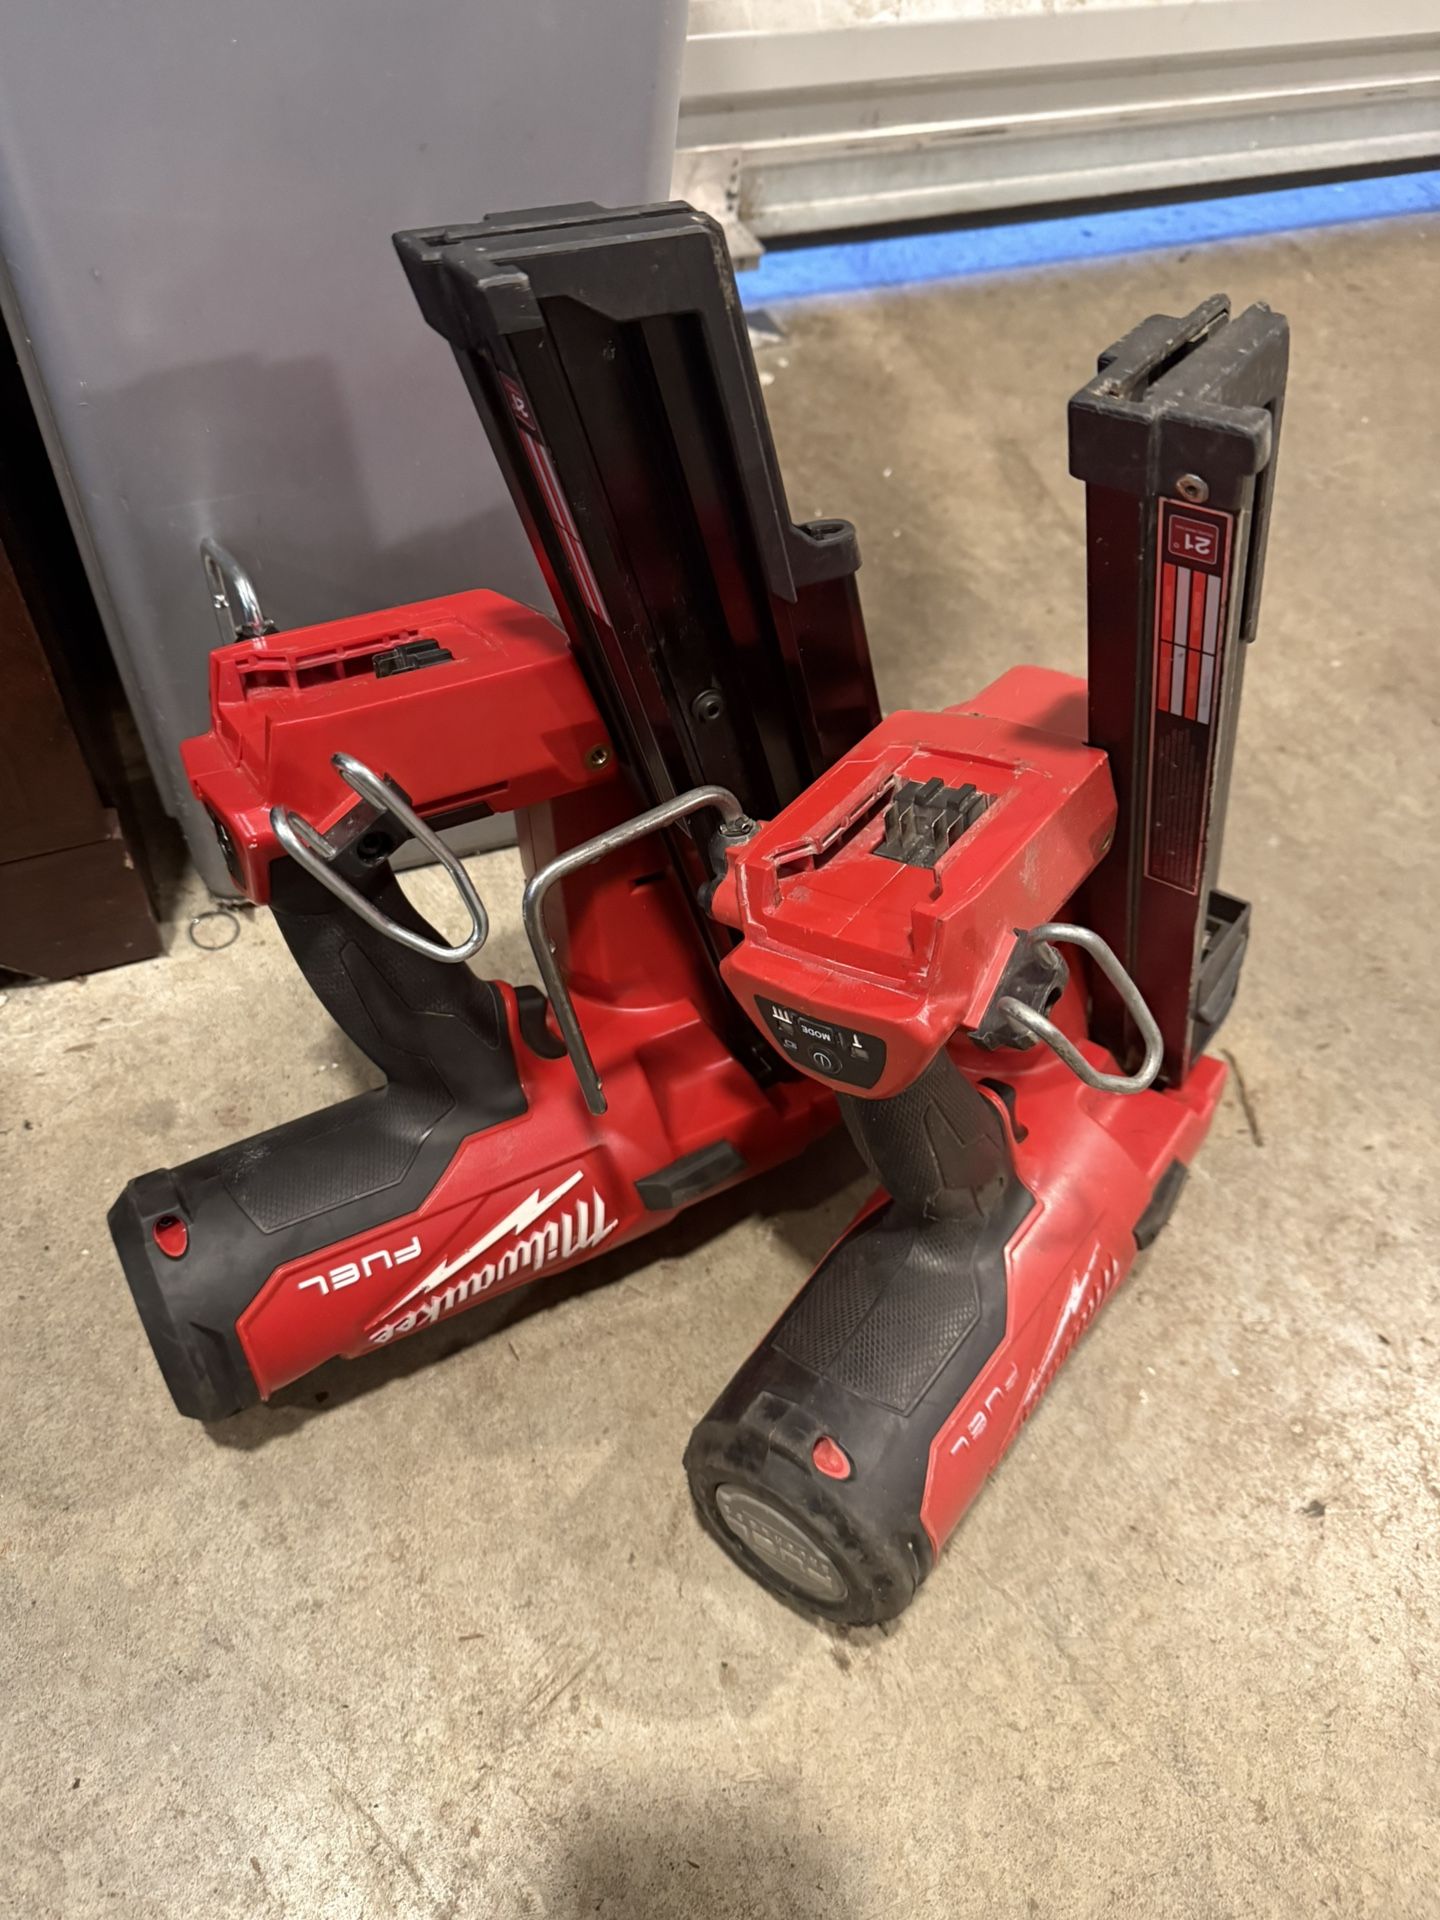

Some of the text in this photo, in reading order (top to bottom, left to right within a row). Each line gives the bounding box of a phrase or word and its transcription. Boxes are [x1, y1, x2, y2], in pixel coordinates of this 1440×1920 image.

[801, 1025, 831, 1042] MODE
[298, 1236, 422, 1295] FUEL
[368, 1186, 619, 1344] Milwaukee
[950, 1361, 1019, 1456] FUEL
